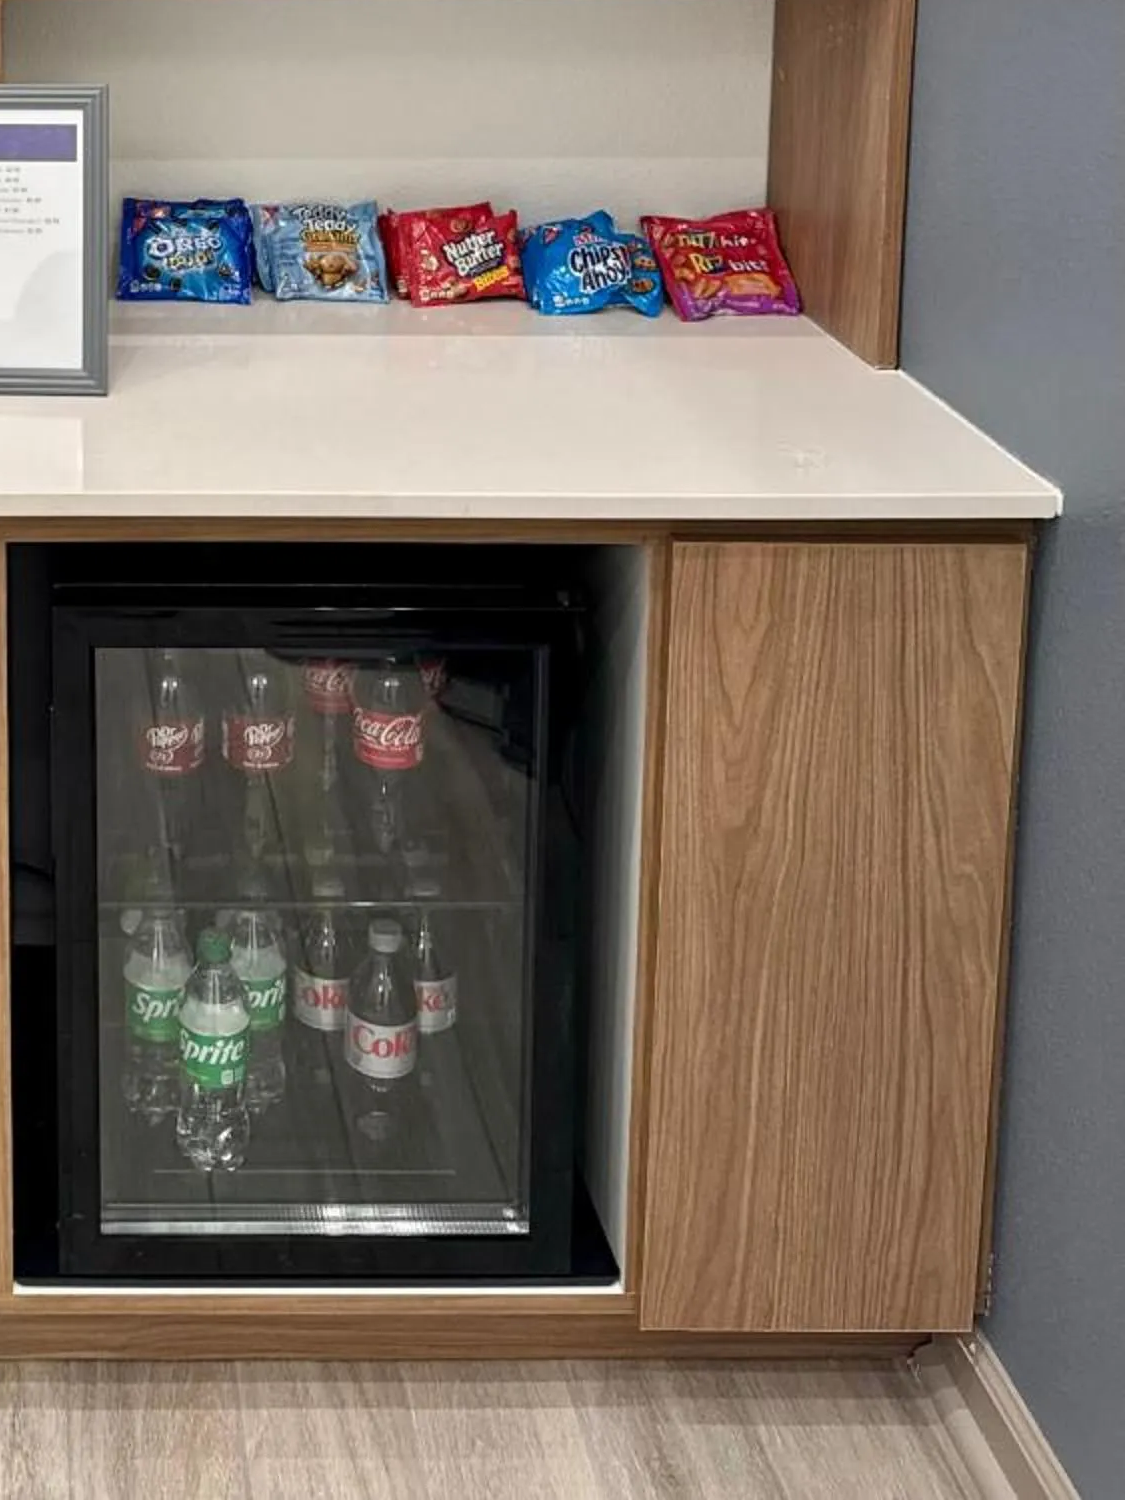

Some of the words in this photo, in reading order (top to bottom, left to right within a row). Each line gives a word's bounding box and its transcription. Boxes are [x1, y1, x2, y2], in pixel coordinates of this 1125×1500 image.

[146, 236, 222, 260] OREO
[443, 231, 495, 260] Nutter
[454, 243, 503, 276] Butter
[570, 245, 621, 273] Chips
